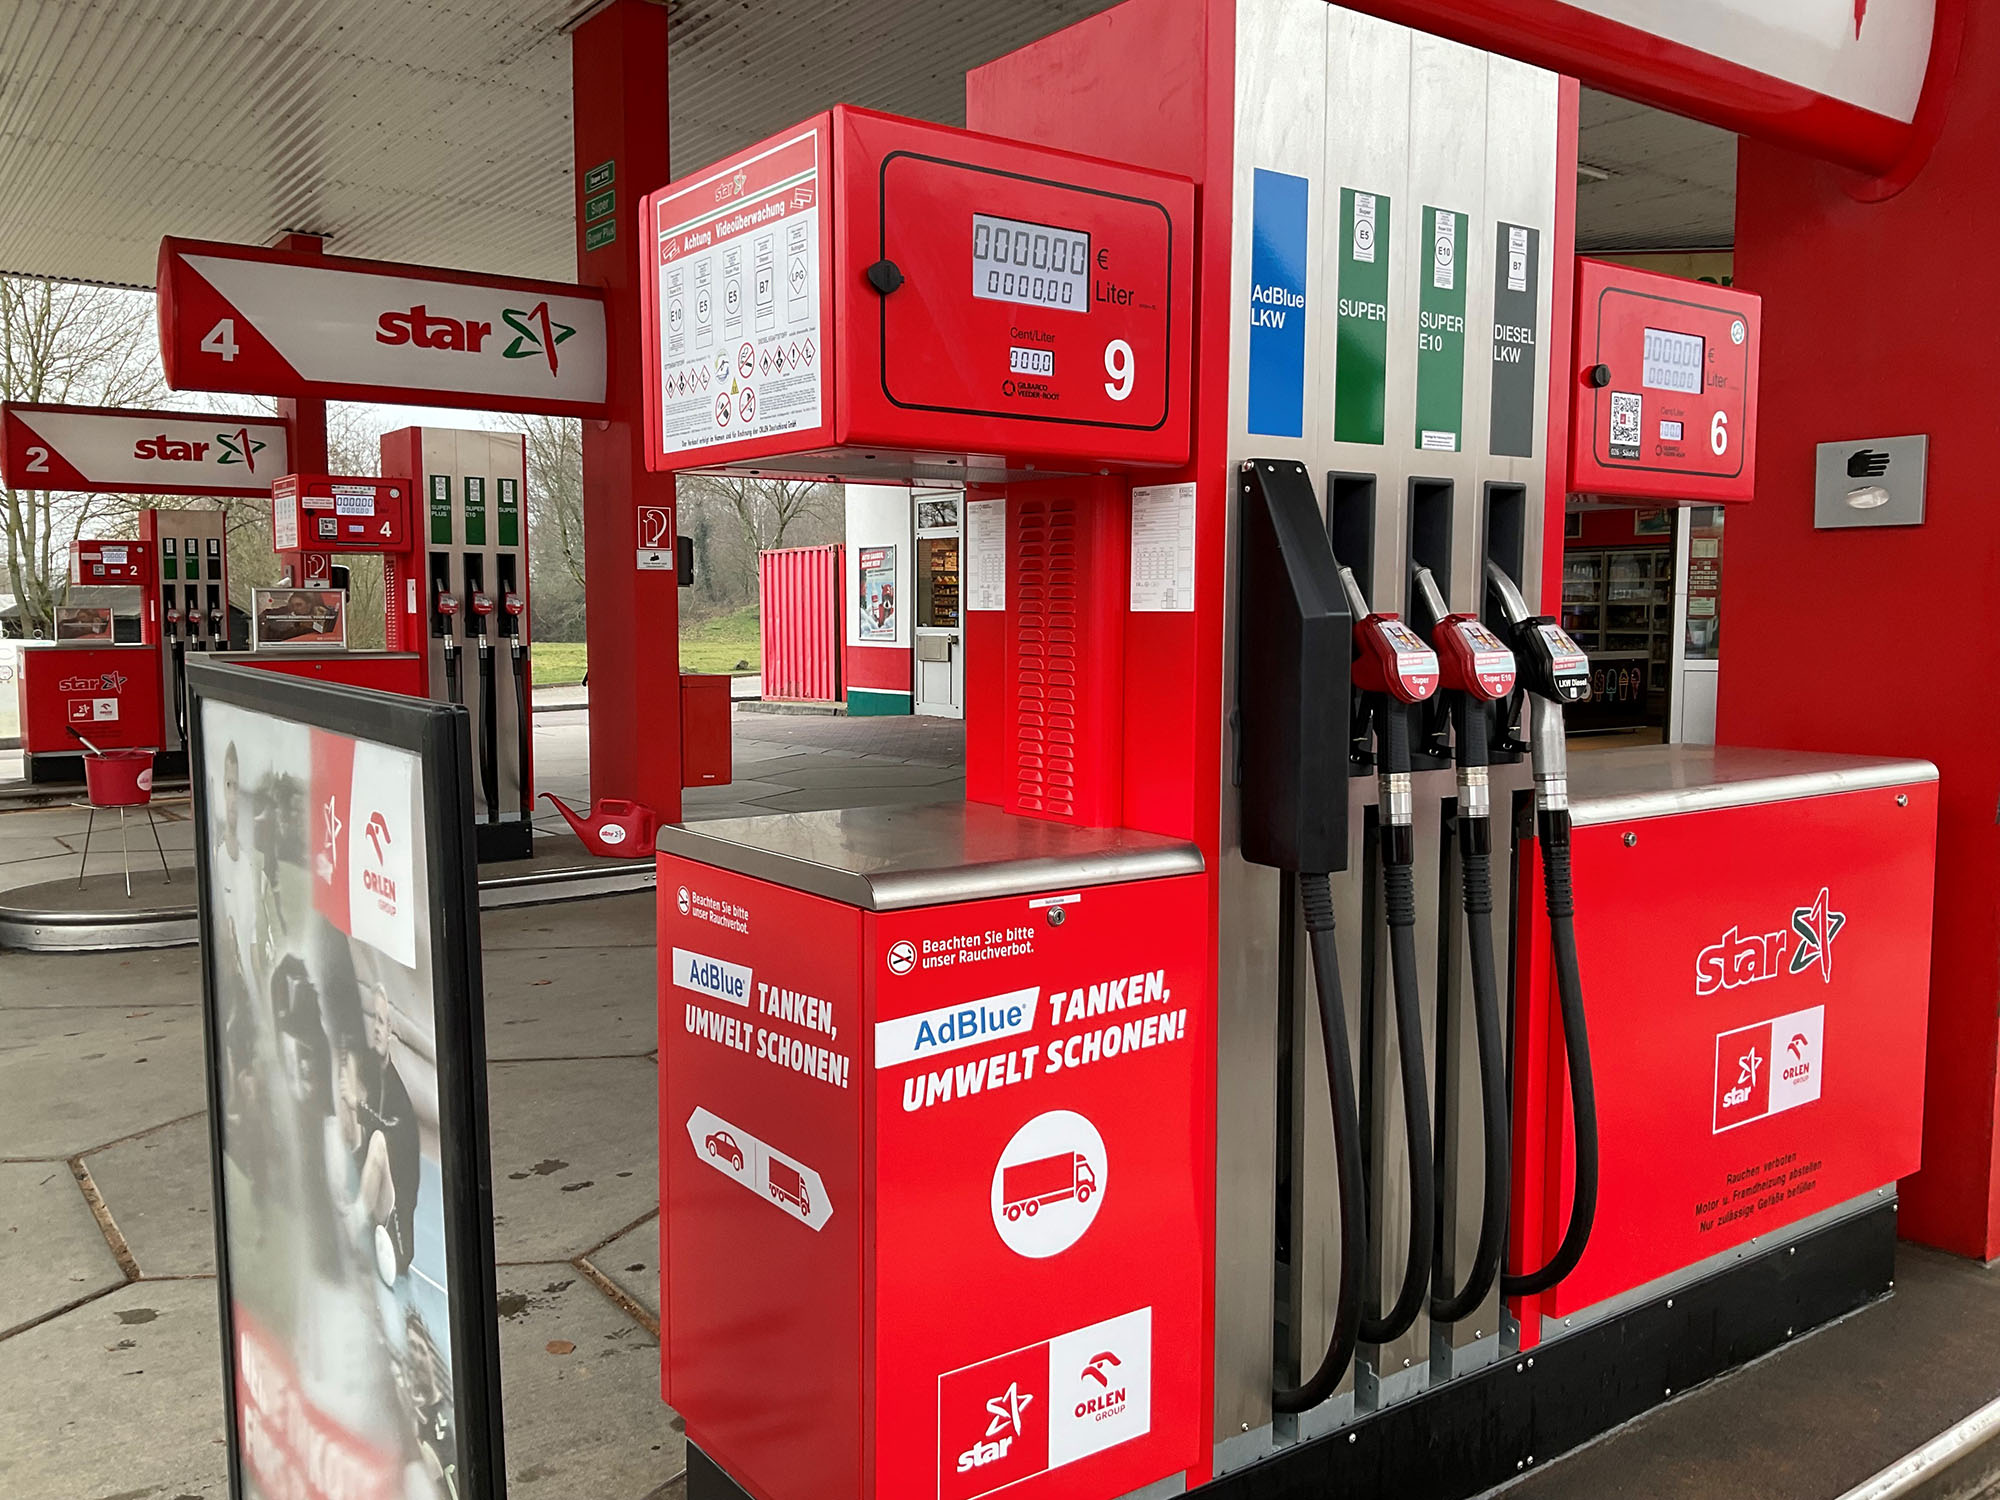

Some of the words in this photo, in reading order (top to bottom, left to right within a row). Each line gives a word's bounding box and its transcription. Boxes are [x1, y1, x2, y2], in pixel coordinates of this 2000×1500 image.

[1359, 207, 1371, 216] Super
[684, 229, 712, 251] Achtung
[715, 201, 785, 238] Videoüberwachung
[1360, 229, 1370, 241] E5
[1097, 248, 1109, 270] €
[1438, 246, 1451, 257] E10
[759, 279, 769, 294] B7
[791, 270, 804, 282] LPG
[728, 290, 738, 304] E5
[1096, 280, 1134, 306] Liter
[1252, 284, 1305, 309] AdBlue
[670, 308, 682, 322] E10
[699, 300, 708, 313] E5
[1339, 299, 1386, 322] SUPER
[376, 304, 492, 353] star
[1251, 308, 1286, 329] LKW
[1420, 311, 1464, 334] SUPER
[201, 318, 240, 362] 4
[1010, 327, 1055, 343] Cent/Liter
[1419, 333, 1443, 352] E10
[1494, 324, 1535, 345] DIESEL
[1493, 346, 1521, 364] LKW
[1708, 347, 1715, 363] €
[1104, 339, 1135, 401] 9
[1706, 370, 1728, 389] Liter
[1711, 410, 1728, 456] 6
[25, 446, 50, 473] 2
[134, 434, 210, 462] star
[380, 521, 392, 537] 4
[129, 565, 138, 576] 2
[59, 676, 99, 691] star
[1412, 676, 1430, 686] Super
[1483, 673, 1500, 683] Super
[1501, 673, 1512, 682] E10
[1559, 679, 1571, 688] LKW
[1571, 678, 1587, 687] Diesel
[363, 869, 396, 903] ORLEN
[692, 891, 721, 911] Beachten
[721, 901, 731, 915] Sie
[732, 904, 749, 921] bitte
[692, 906, 708, 921] unser
[709, 910, 749, 935] Rauchverbot.
[922, 933, 981, 953] Beachten
[984, 930, 1003, 944] Sie
[1006, 927, 1035, 942] bitte
[922, 952, 956, 969] unser
[959, 940, 1035, 964] Rauchverbot.
[1696, 925, 1787, 996] star
[1049, 969, 1171, 1026] TANKEN,
[758, 982, 838, 1041] TANKEN,
[685, 1003, 753, 1053] UMWELT
[756, 1027, 850, 1089] SCHONEN!
[902, 1045, 1040, 1113] UMWELT
[1045, 1009, 1187, 1074] SCHONEN!
[1783, 1062, 1810, 1080] ORLEN
[1722, 1086, 1752, 1108] star
[1726, 1165, 1760, 1186] Rauchen
[1763, 1151, 1797, 1173] verboten
[1695, 1199, 1719, 1216] Motor
[1733, 1173, 1787, 1201] Fremdheizung
[1789, 1160, 1823, 1181] abstellen
[1700, 1219, 1715, 1233] Nur
[1717, 1203, 1755, 1227] zulässige
[1787, 1179, 1817, 1199] befüllen
[1074, 1387, 1126, 1419] ORLEN
[1095, 1404, 1126, 1422] GROUP
[957, 1435, 1012, 1473] star
